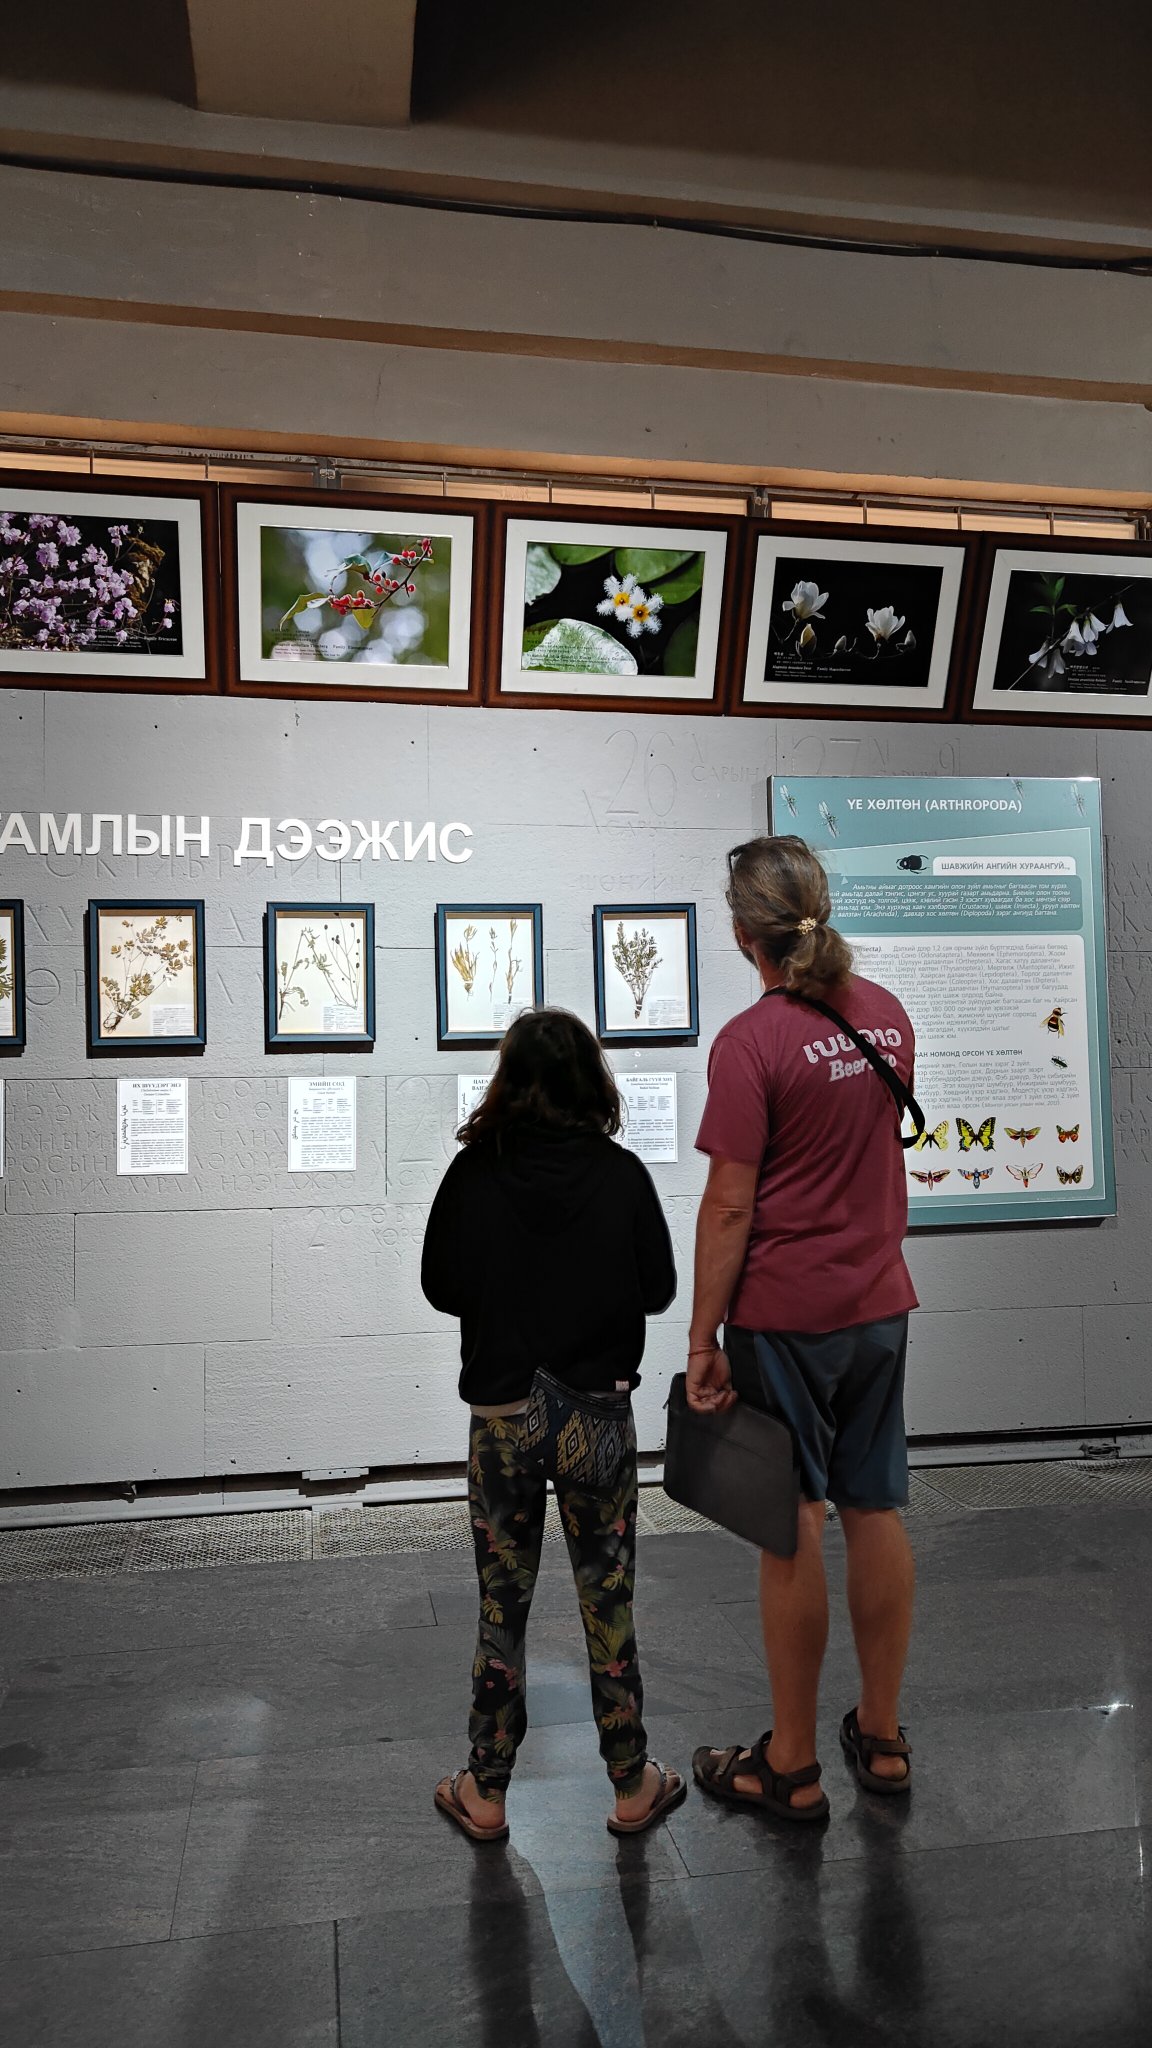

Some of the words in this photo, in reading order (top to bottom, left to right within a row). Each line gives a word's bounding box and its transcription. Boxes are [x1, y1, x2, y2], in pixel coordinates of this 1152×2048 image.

[847, 799, 863, 811] ҮЕ
[867, 799, 922, 811] ХӨЛТӨН
[925, 799, 1023, 813] (ARTHROPODA)
[0, 812, 210, 858] АМЛЫН
[233, 816, 475, 868] ДЭЭЖИС
[941, 862, 984, 871] ШАВЖИЙН
[986, 862, 1017, 871] АНГИЙН
